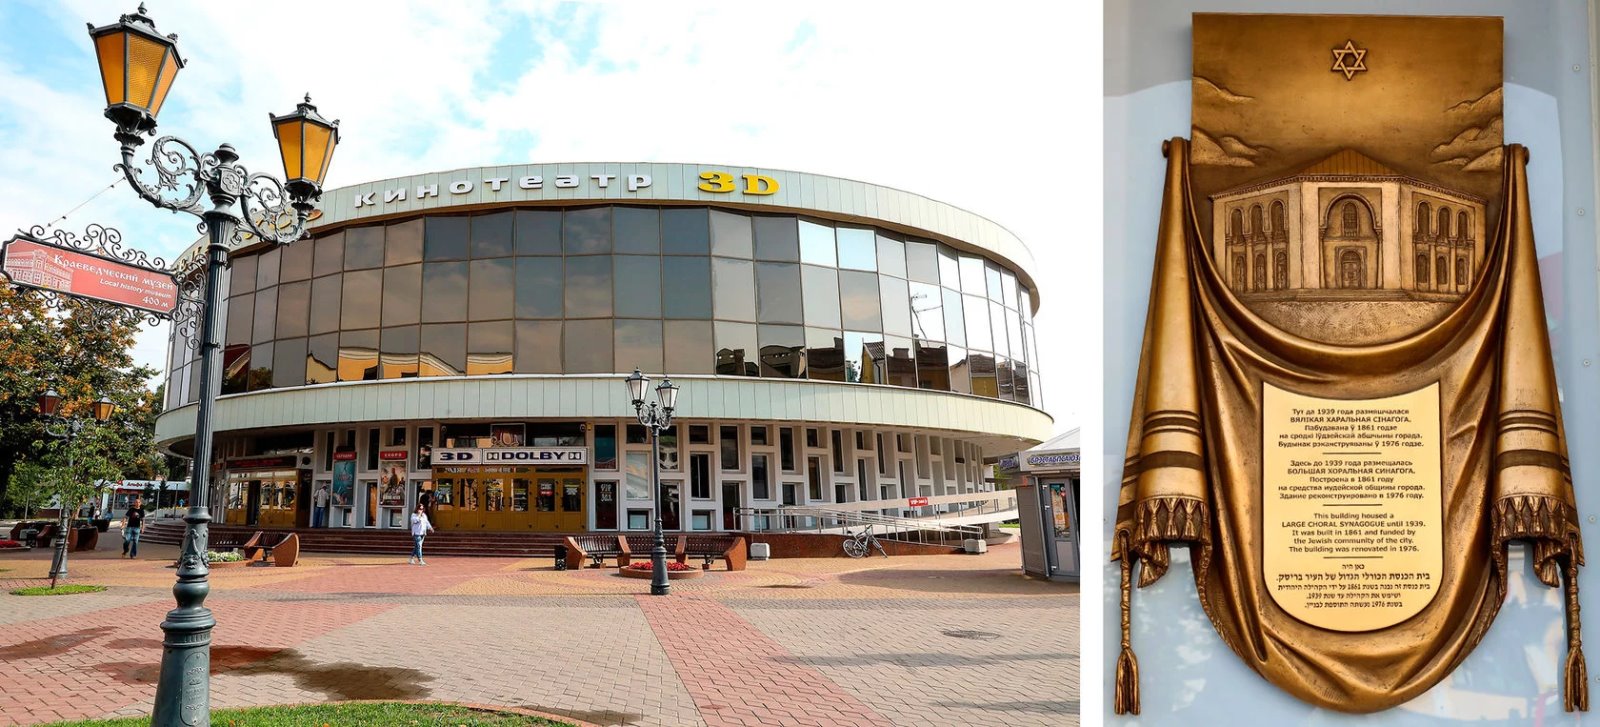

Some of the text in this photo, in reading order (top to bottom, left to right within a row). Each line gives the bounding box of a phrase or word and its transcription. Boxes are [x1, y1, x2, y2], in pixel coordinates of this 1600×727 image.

[696, 171, 780, 195] 3D
[53, 254, 174, 291] Краеведческий музей
[99, 278, 172, 299] Local history museum
[142, 296, 160, 306] 400
[1292, 408, 1304, 416] Тут
[1304, 424, 1349, 432] Пабудавана
[440, 452, 473, 460] 3D
[501, 452, 566, 460] DOLBY
[1324, 484, 1363, 492] иудейской
[1339, 520, 1385, 528] SYNAGOGUE
[1334, 537, 1375, 545] community
